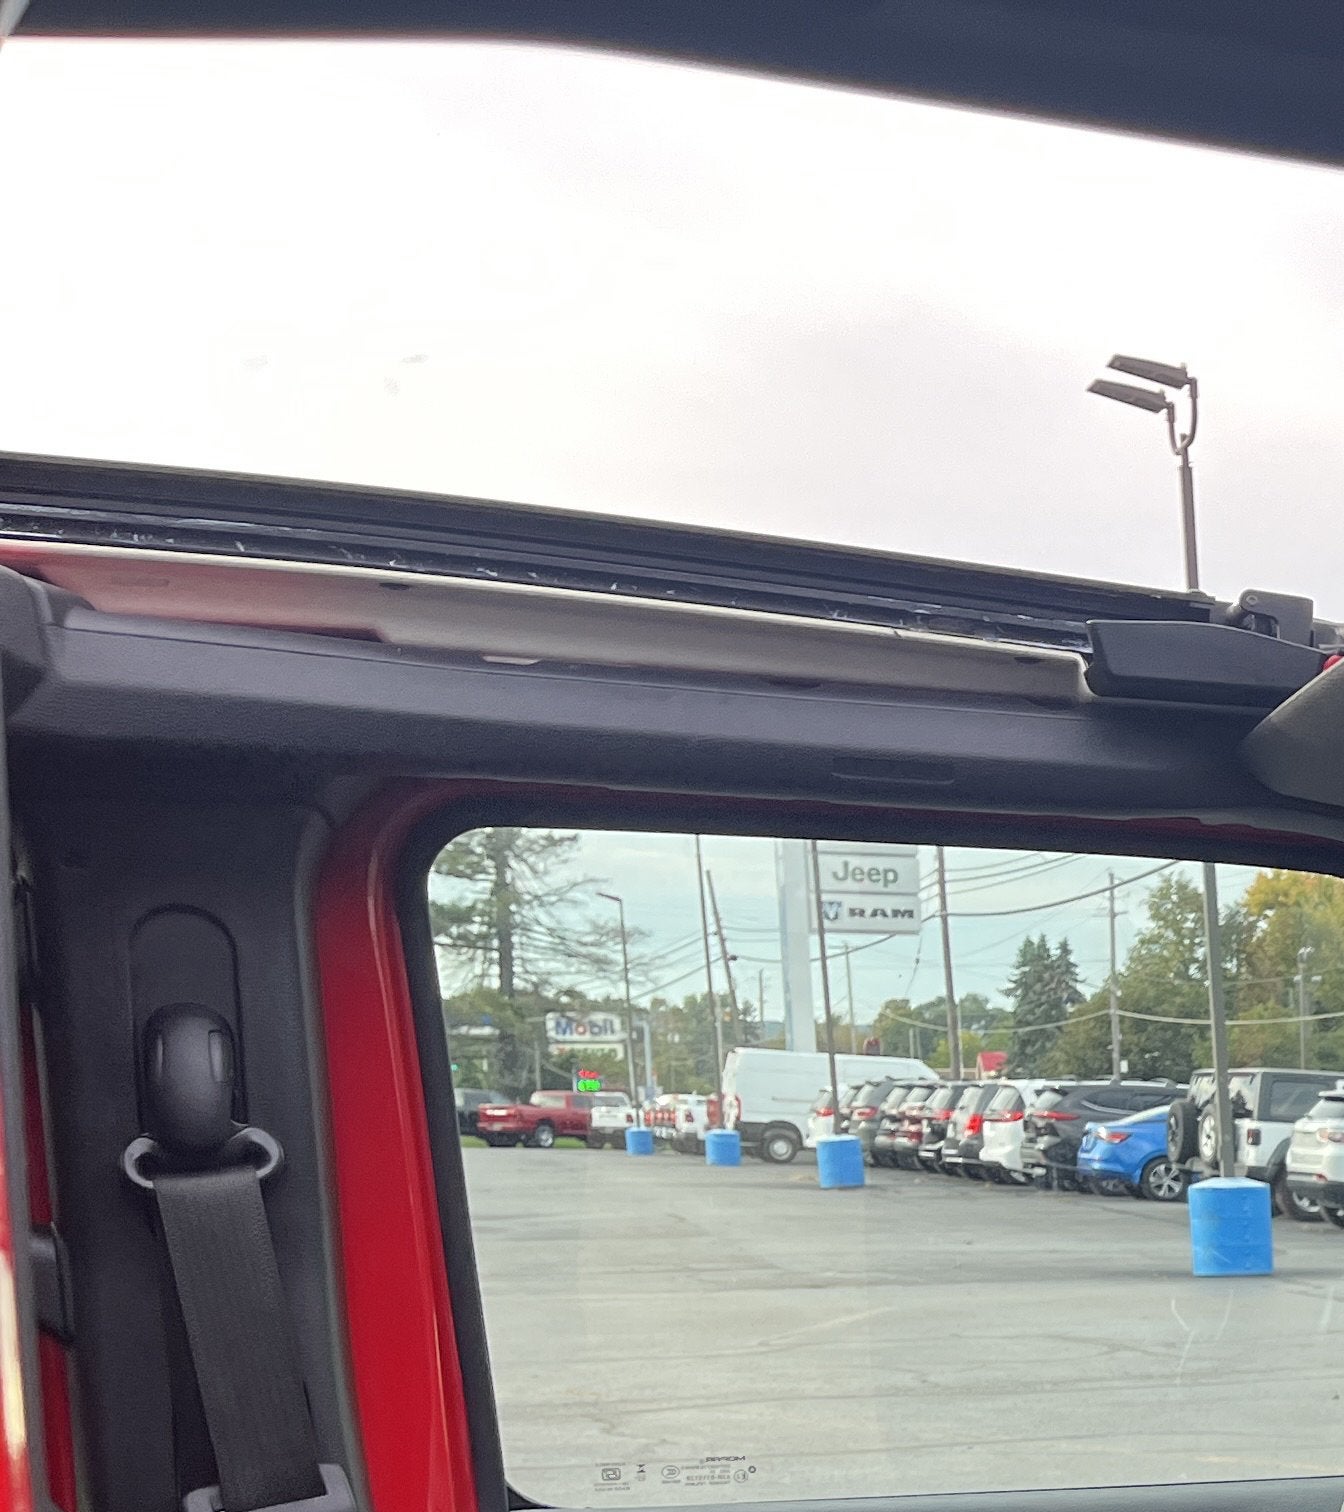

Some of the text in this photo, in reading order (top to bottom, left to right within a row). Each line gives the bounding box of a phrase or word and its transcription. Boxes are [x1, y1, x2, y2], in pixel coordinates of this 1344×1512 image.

[832, 860, 898, 888] Jeep
[848, 907, 914, 919] RAM
[555, 1017, 615, 1037] Mobil
